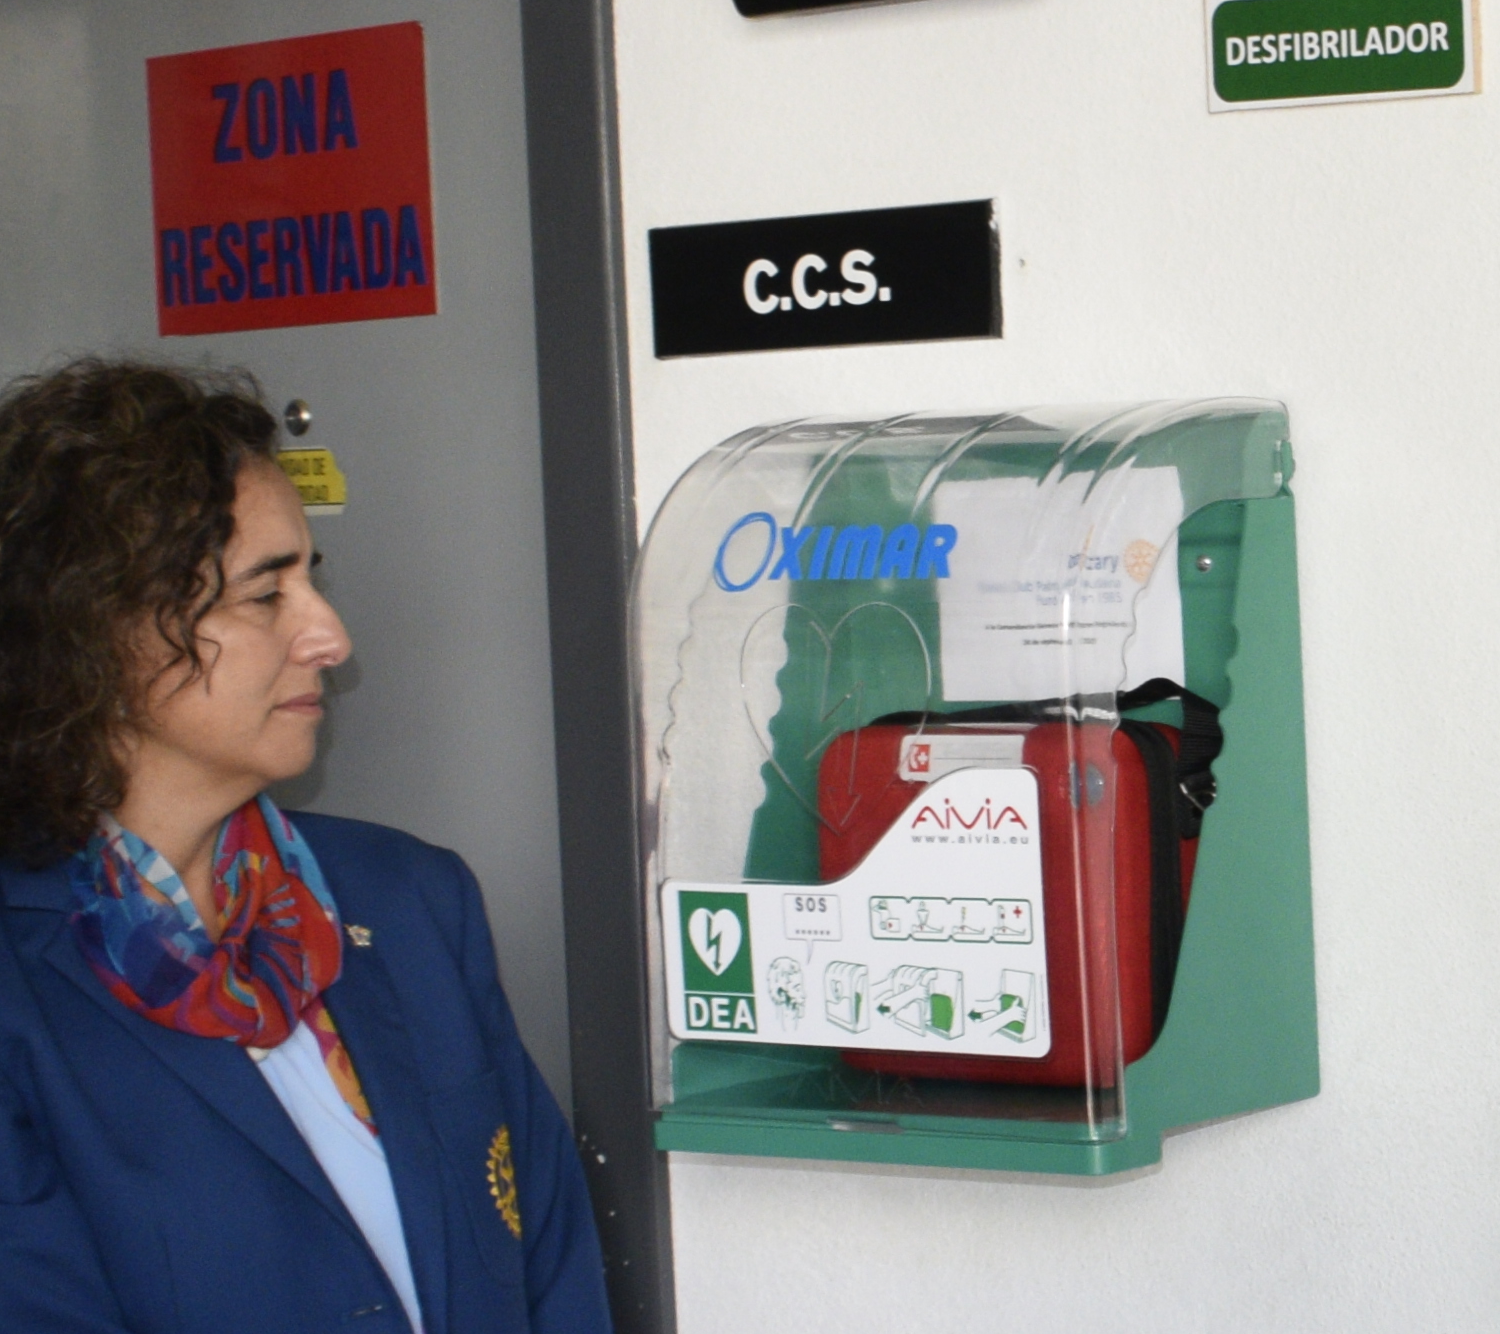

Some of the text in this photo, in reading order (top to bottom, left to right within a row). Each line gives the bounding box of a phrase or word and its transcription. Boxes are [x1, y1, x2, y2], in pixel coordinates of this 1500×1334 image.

[1225, 21, 1449, 66] DESFIBRILADOR
[211, 68, 358, 163] ZONA
[161, 205, 427, 309] RESERVADA
[743, 249, 891, 315] C.C.S.
[911, 834, 1029, 845] www.aivia.eu
[795, 896, 828, 913] SOS
[688, 996, 755, 1030] DEA
